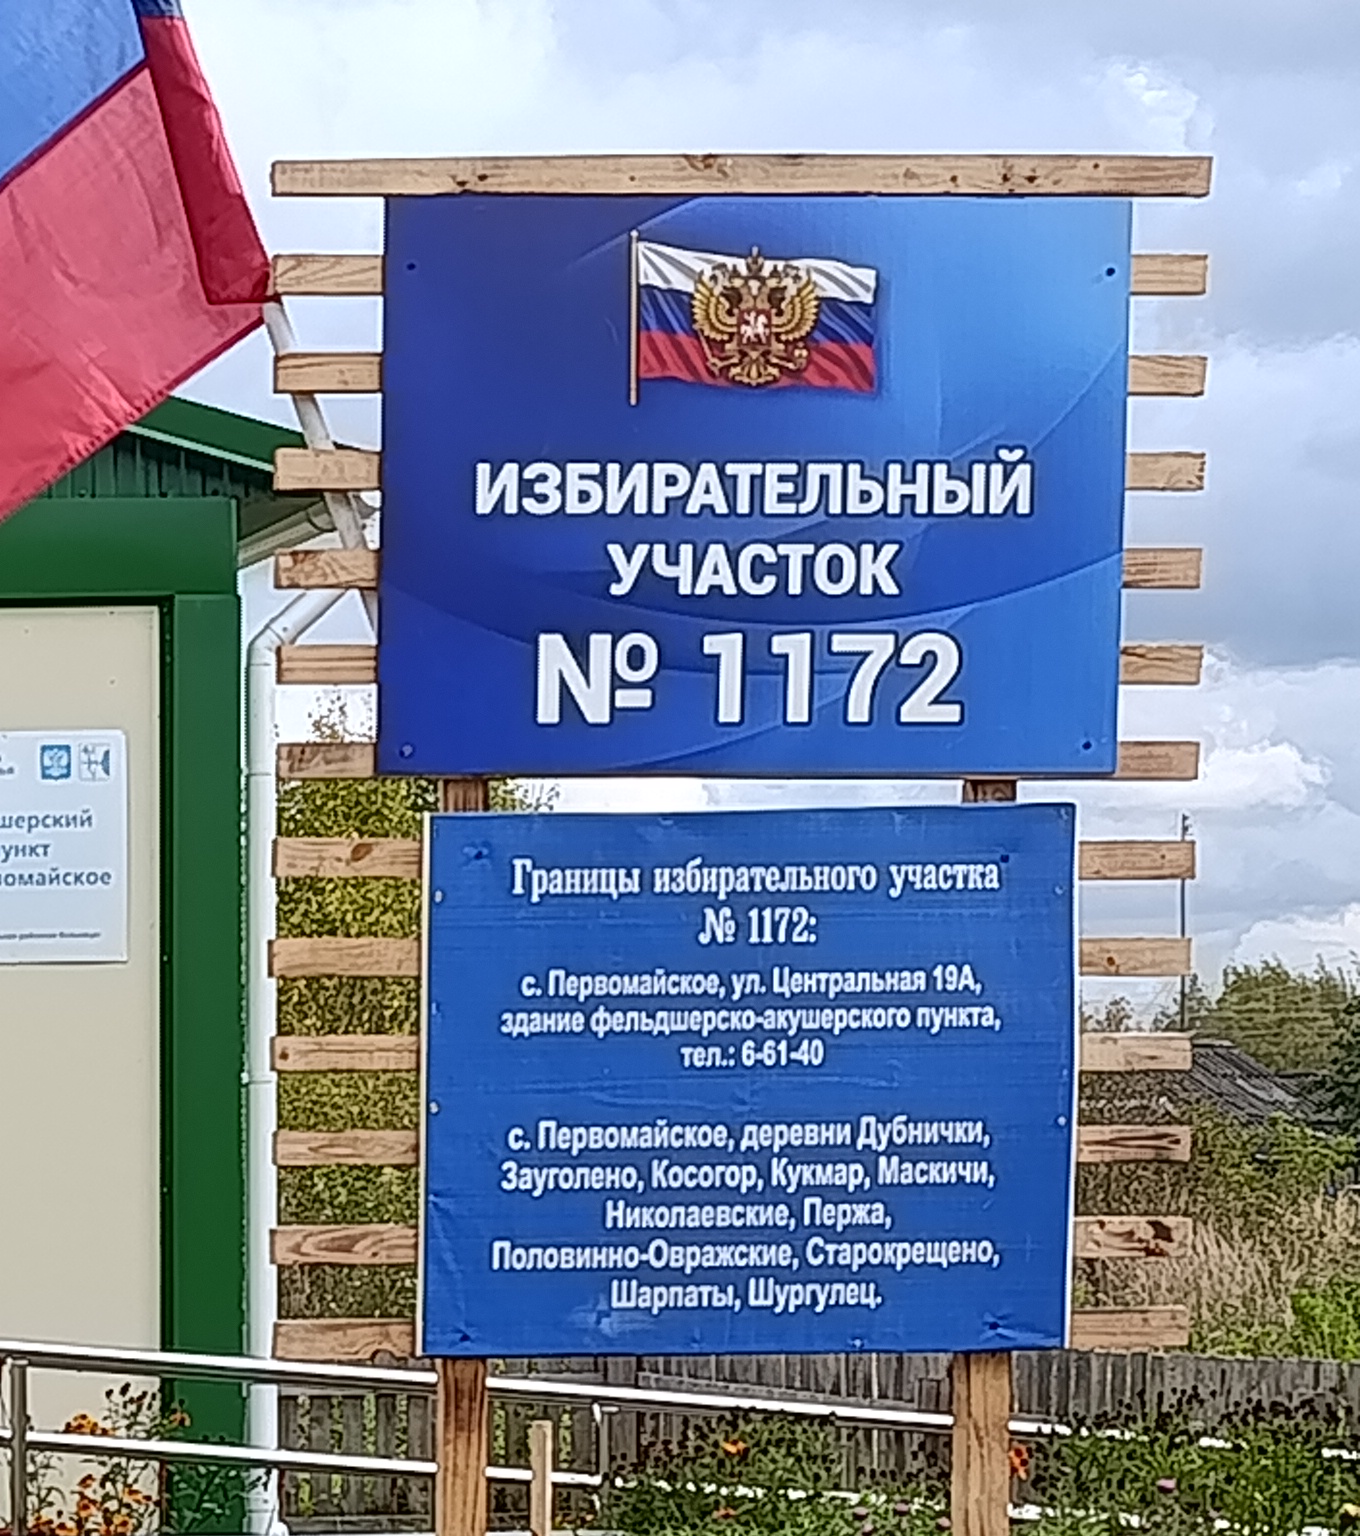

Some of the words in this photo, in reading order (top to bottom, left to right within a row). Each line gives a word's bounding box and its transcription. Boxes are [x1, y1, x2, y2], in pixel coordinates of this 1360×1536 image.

[475, 449, 1032, 515] ИЗБИРАТЕЛЬНЫЙ
[607, 543, 900, 596] УЧАСТОК
[536, 632, 658, 725] №
[703, 632, 962, 724] 1172
[512, 858, 641, 903] Границы
[653, 857, 878, 900] избирательного
[889, 862, 1000, 898] участка
[698, 906, 736, 944] №
[748, 906, 818, 943] 1172:
[521, 977, 542, 998] с.
[548, 968, 726, 1003] Первомайское,
[731, 974, 766, 1001] ул.
[773, 966, 926, 998] Центральная
[932, 965, 983, 995] 19А,
[501, 1011, 585, 1037] здание
[590, 1005, 912, 1038] фельдшерско-акушерского
[916, 1006, 1002, 1034] пункта,
[680, 1046, 735, 1067] тел.:
[741, 1039, 824, 1067] 6-61-40
[508, 1128, 531, 1150] с.
[538, 1119, 735, 1156] Первомайское,
[740, 1123, 852, 1153] деревни
[856, 1115, 991, 1152] Дубнички,
[501, 1160, 644, 1197] Зауголено,
[652, 1159, 764, 1194] Косогор,
[771, 1157, 871, 1193] Кукмар,
[877, 1154, 996, 1188] Маскичи,
[606, 1200, 796, 1232] Николаевские,
[803, 1196, 893, 1232] Пержа,
[492, 1239, 799, 1274] Половинно-Овражские,
[806, 1236, 1000, 1272] Старокрещено,
[611, 1279, 741, 1315] Шарпаты,
[748, 1277, 882, 1313] Шургулец.
